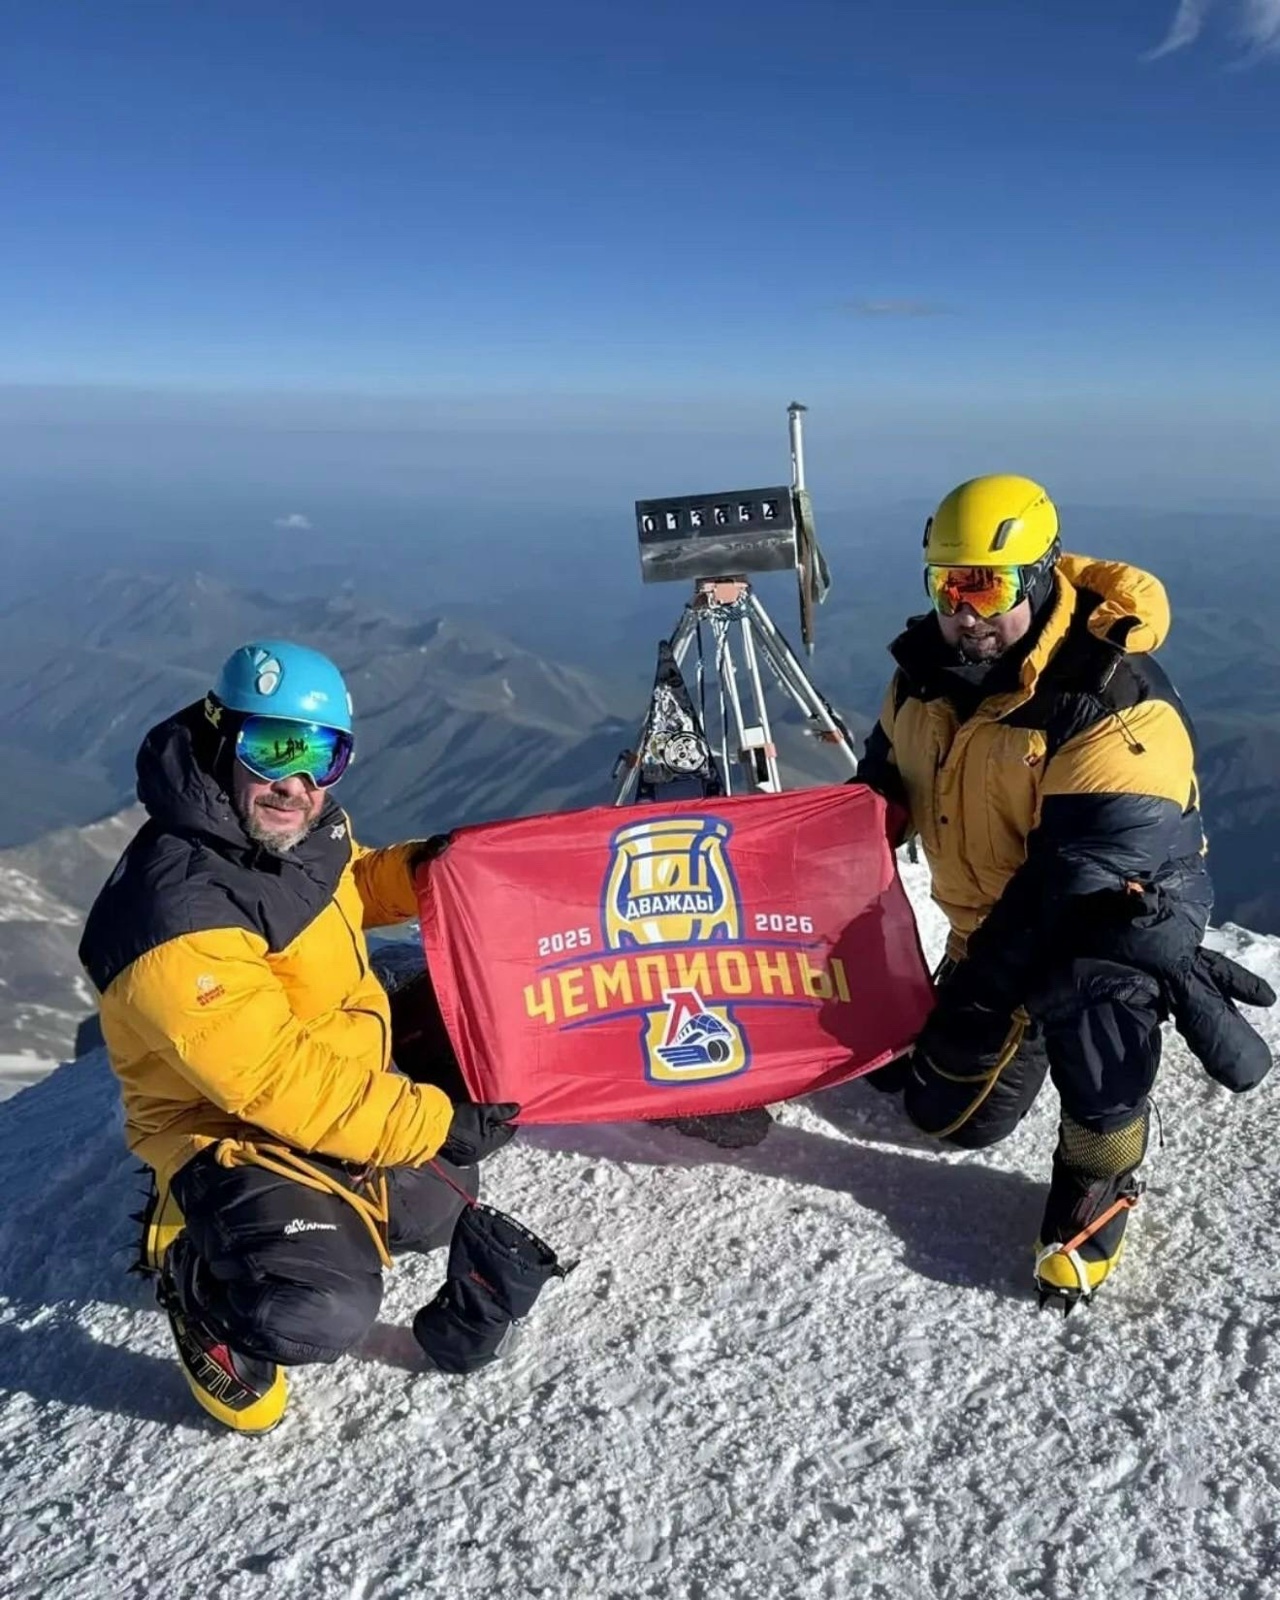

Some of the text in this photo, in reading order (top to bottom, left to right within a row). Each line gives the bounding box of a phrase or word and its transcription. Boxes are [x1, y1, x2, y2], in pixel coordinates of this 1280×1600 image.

[643, 501, 778, 533] 013654
[626, 894, 714, 920] ДВАЖДЫ
[755, 914, 814, 933] 2026
[538, 927, 592, 956] 2025
[523, 950, 851, 1024] ЧЕМПИОНЫ
